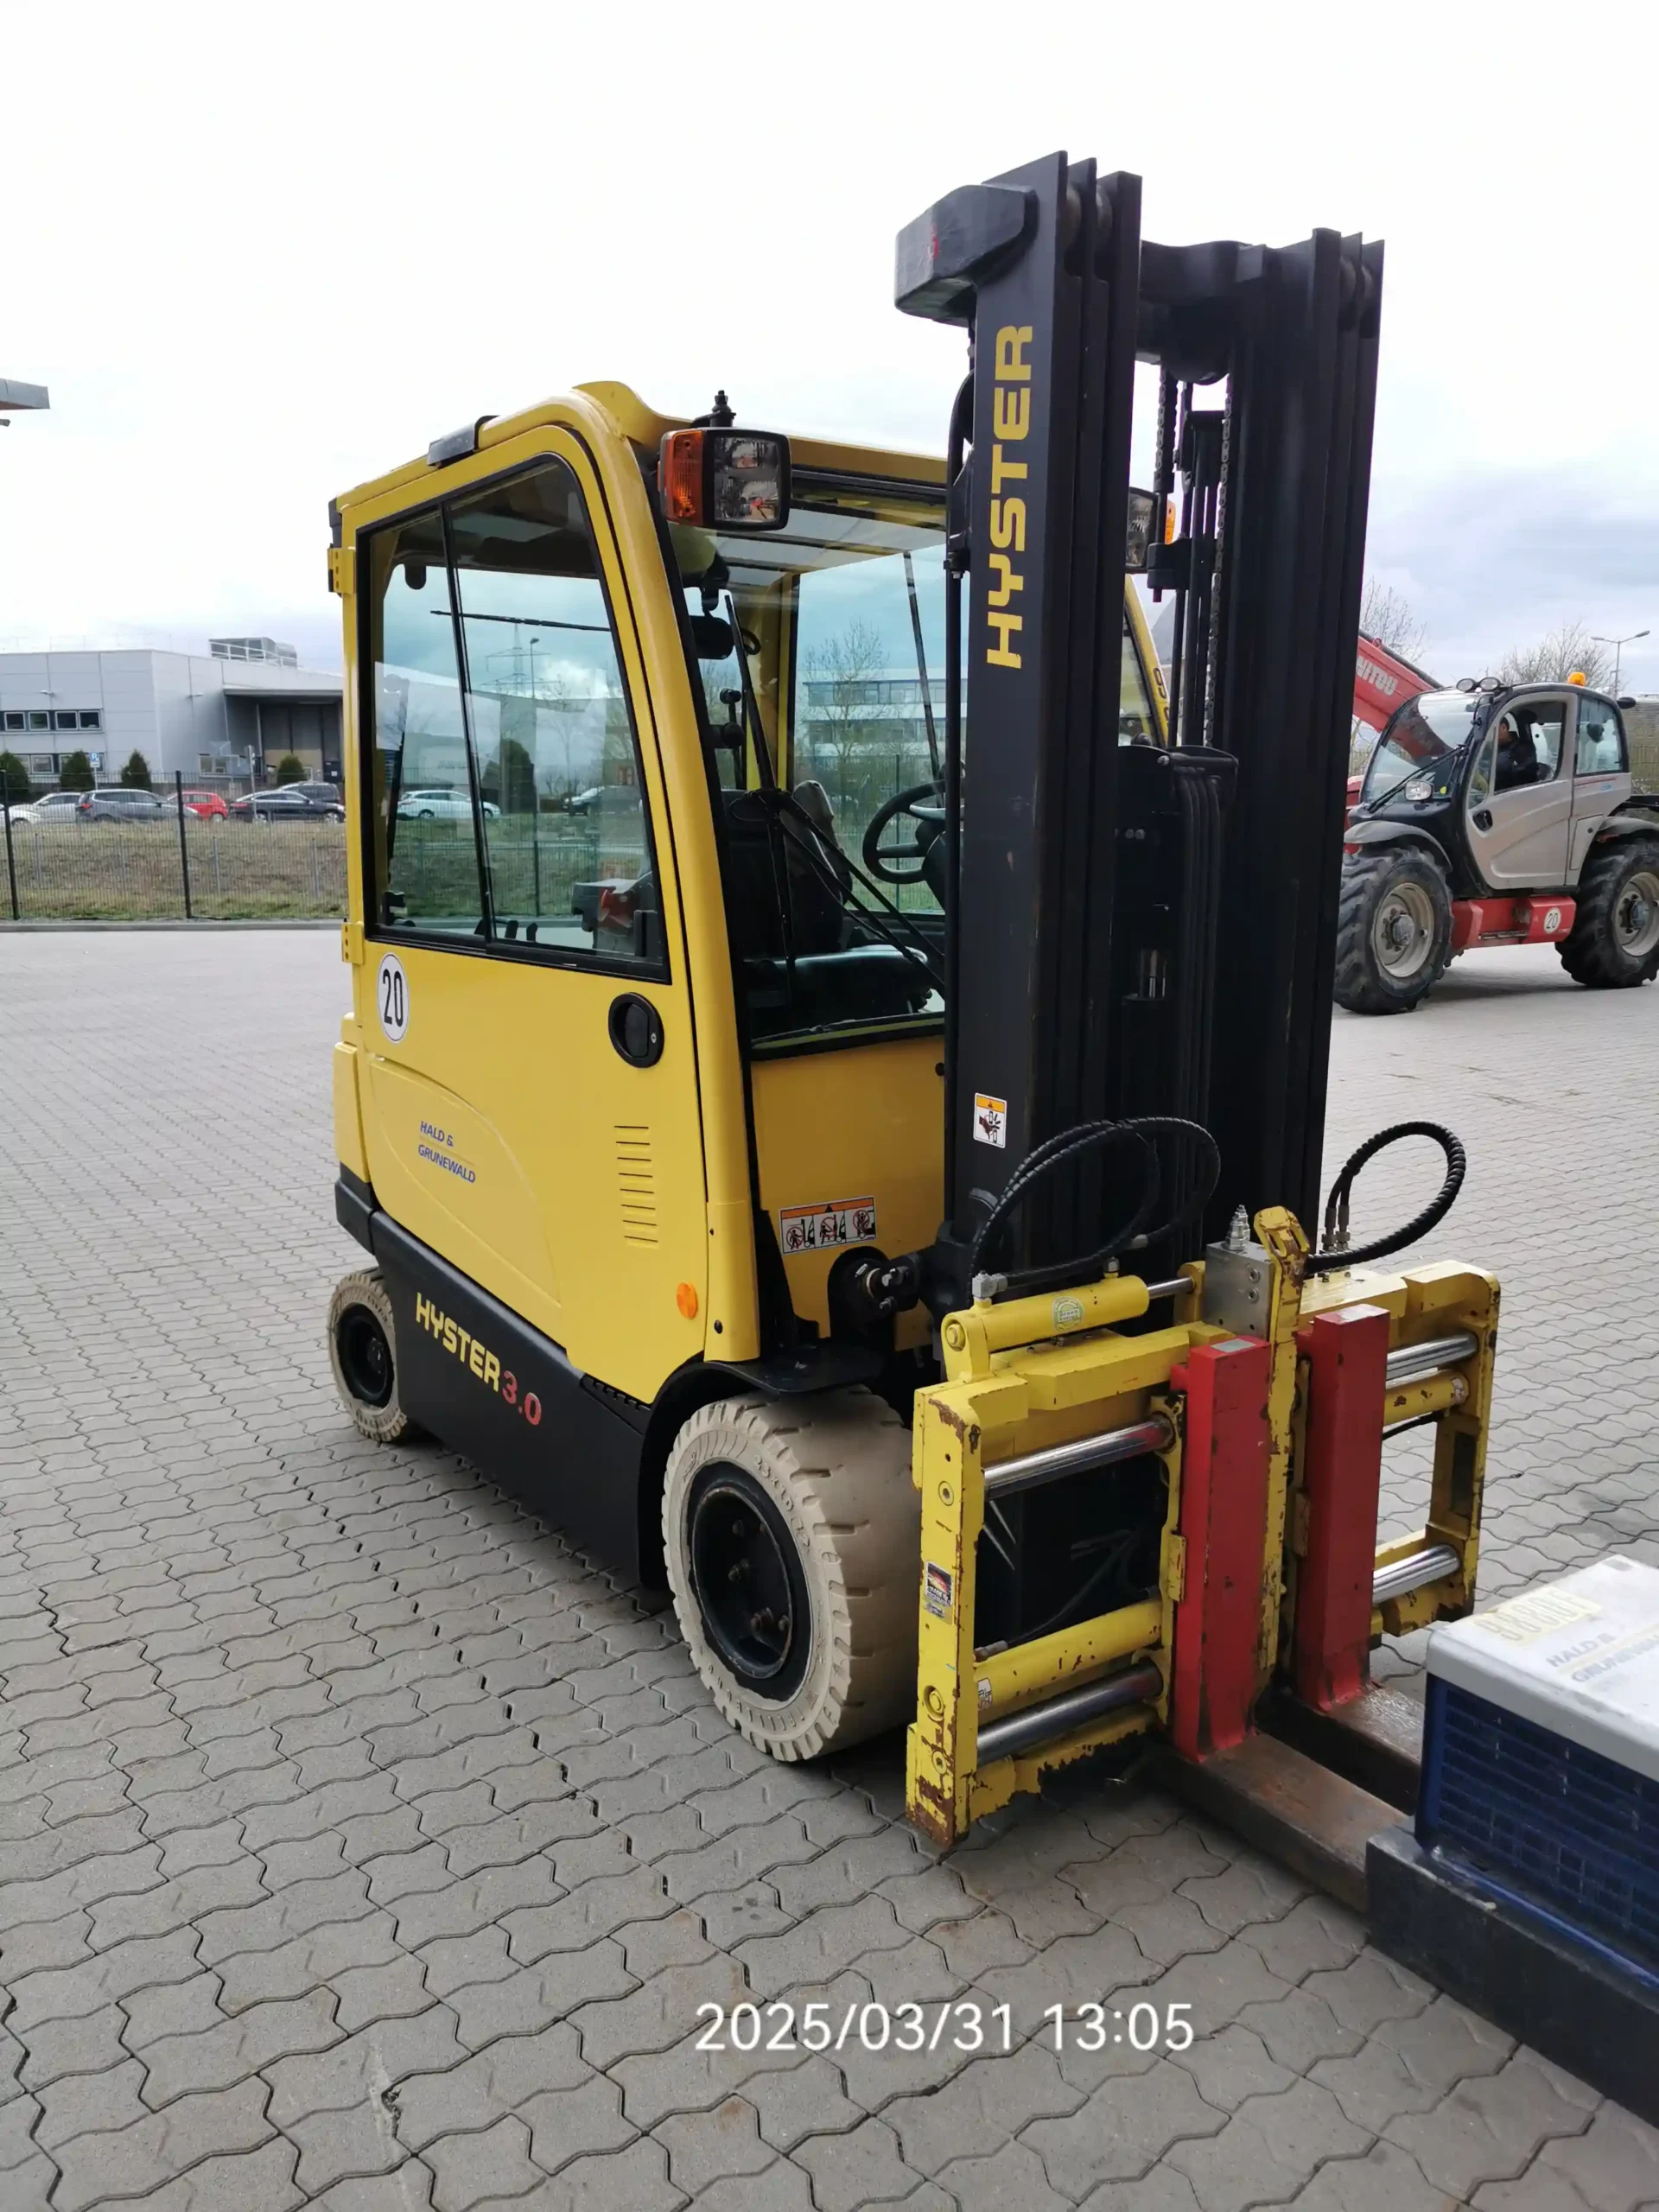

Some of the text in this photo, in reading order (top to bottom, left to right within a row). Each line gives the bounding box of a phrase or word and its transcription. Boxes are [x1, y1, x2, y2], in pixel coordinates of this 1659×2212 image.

[987, 326, 1033, 669] HYSTER
[1546, 912, 1559, 929] 20
[383, 969, 404, 1027] 20
[420, 1120, 454, 1147] HALD &
[418, 1144, 476, 1183] GRUNEWALD
[416, 1292, 542, 1426] HYSTER 3.0
